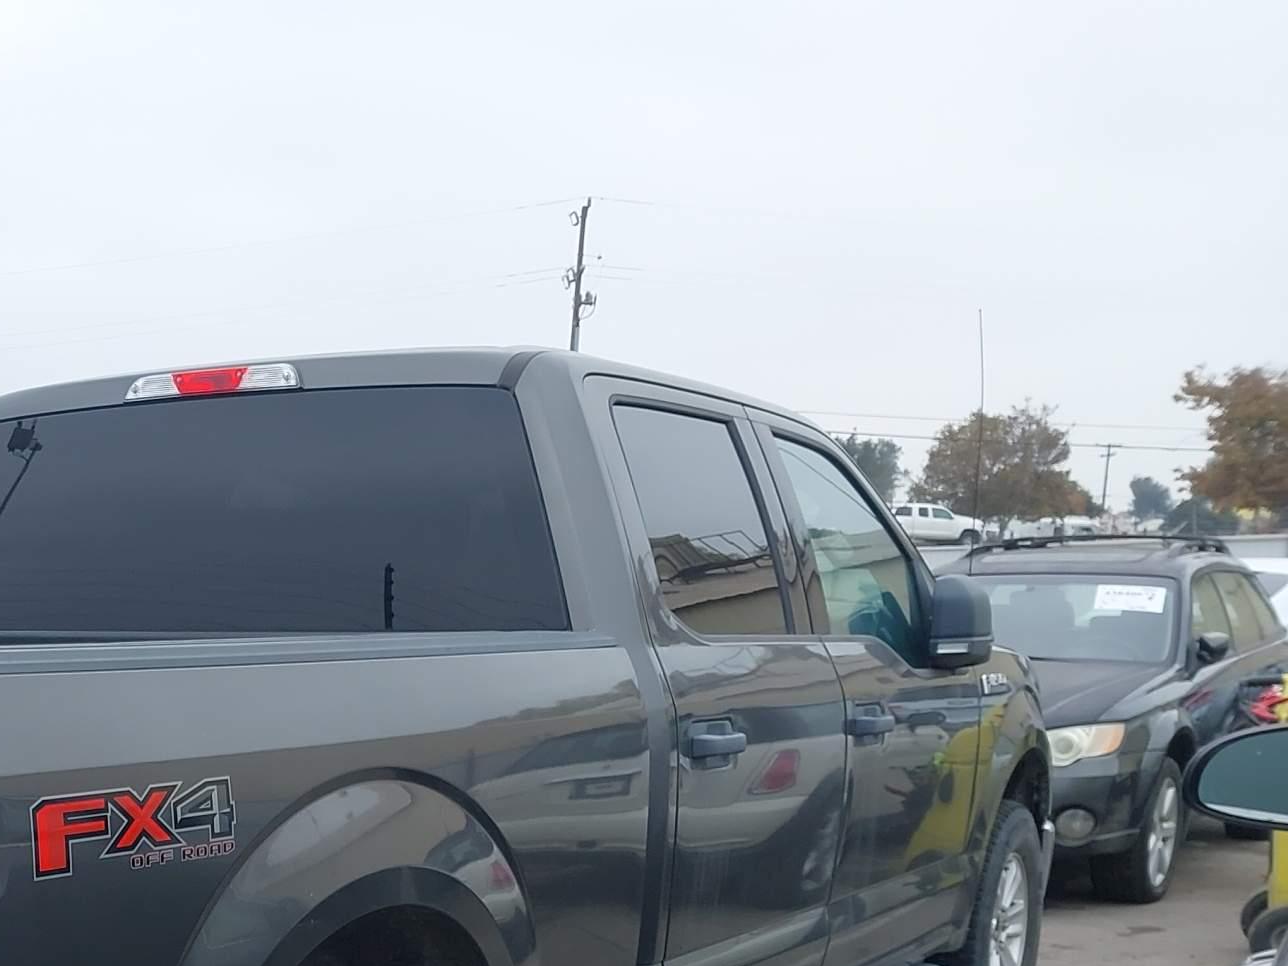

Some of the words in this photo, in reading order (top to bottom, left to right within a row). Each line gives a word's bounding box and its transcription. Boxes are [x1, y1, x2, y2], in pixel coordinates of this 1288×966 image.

[30, 776, 236, 881] FX4
[130, 848, 174, 869] OFF
[181, 840, 236, 862] ROAD
